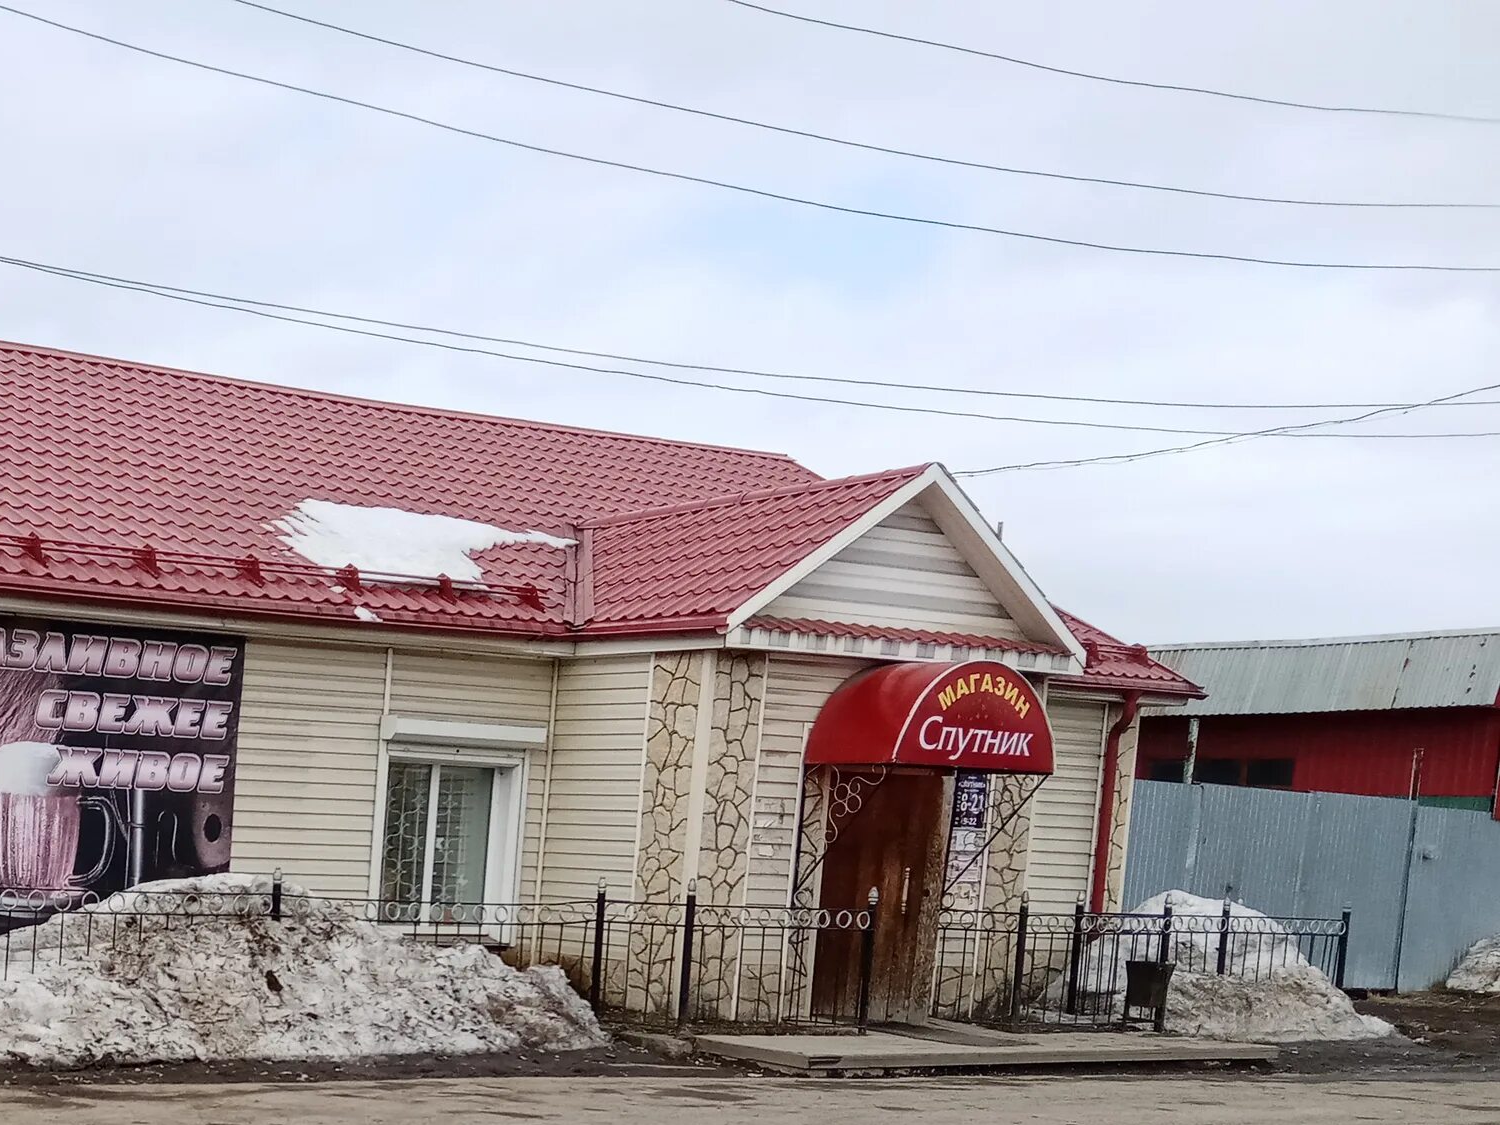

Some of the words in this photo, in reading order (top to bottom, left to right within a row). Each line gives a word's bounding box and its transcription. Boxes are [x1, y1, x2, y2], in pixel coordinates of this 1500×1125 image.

[34, 689, 232, 740] СВЕЖЕЕ
[937, 673, 1031, 719] МАГАЗИН
[918, 715, 1034, 760] Спутник
[46, 745, 231, 794] ЖИВОЕ
